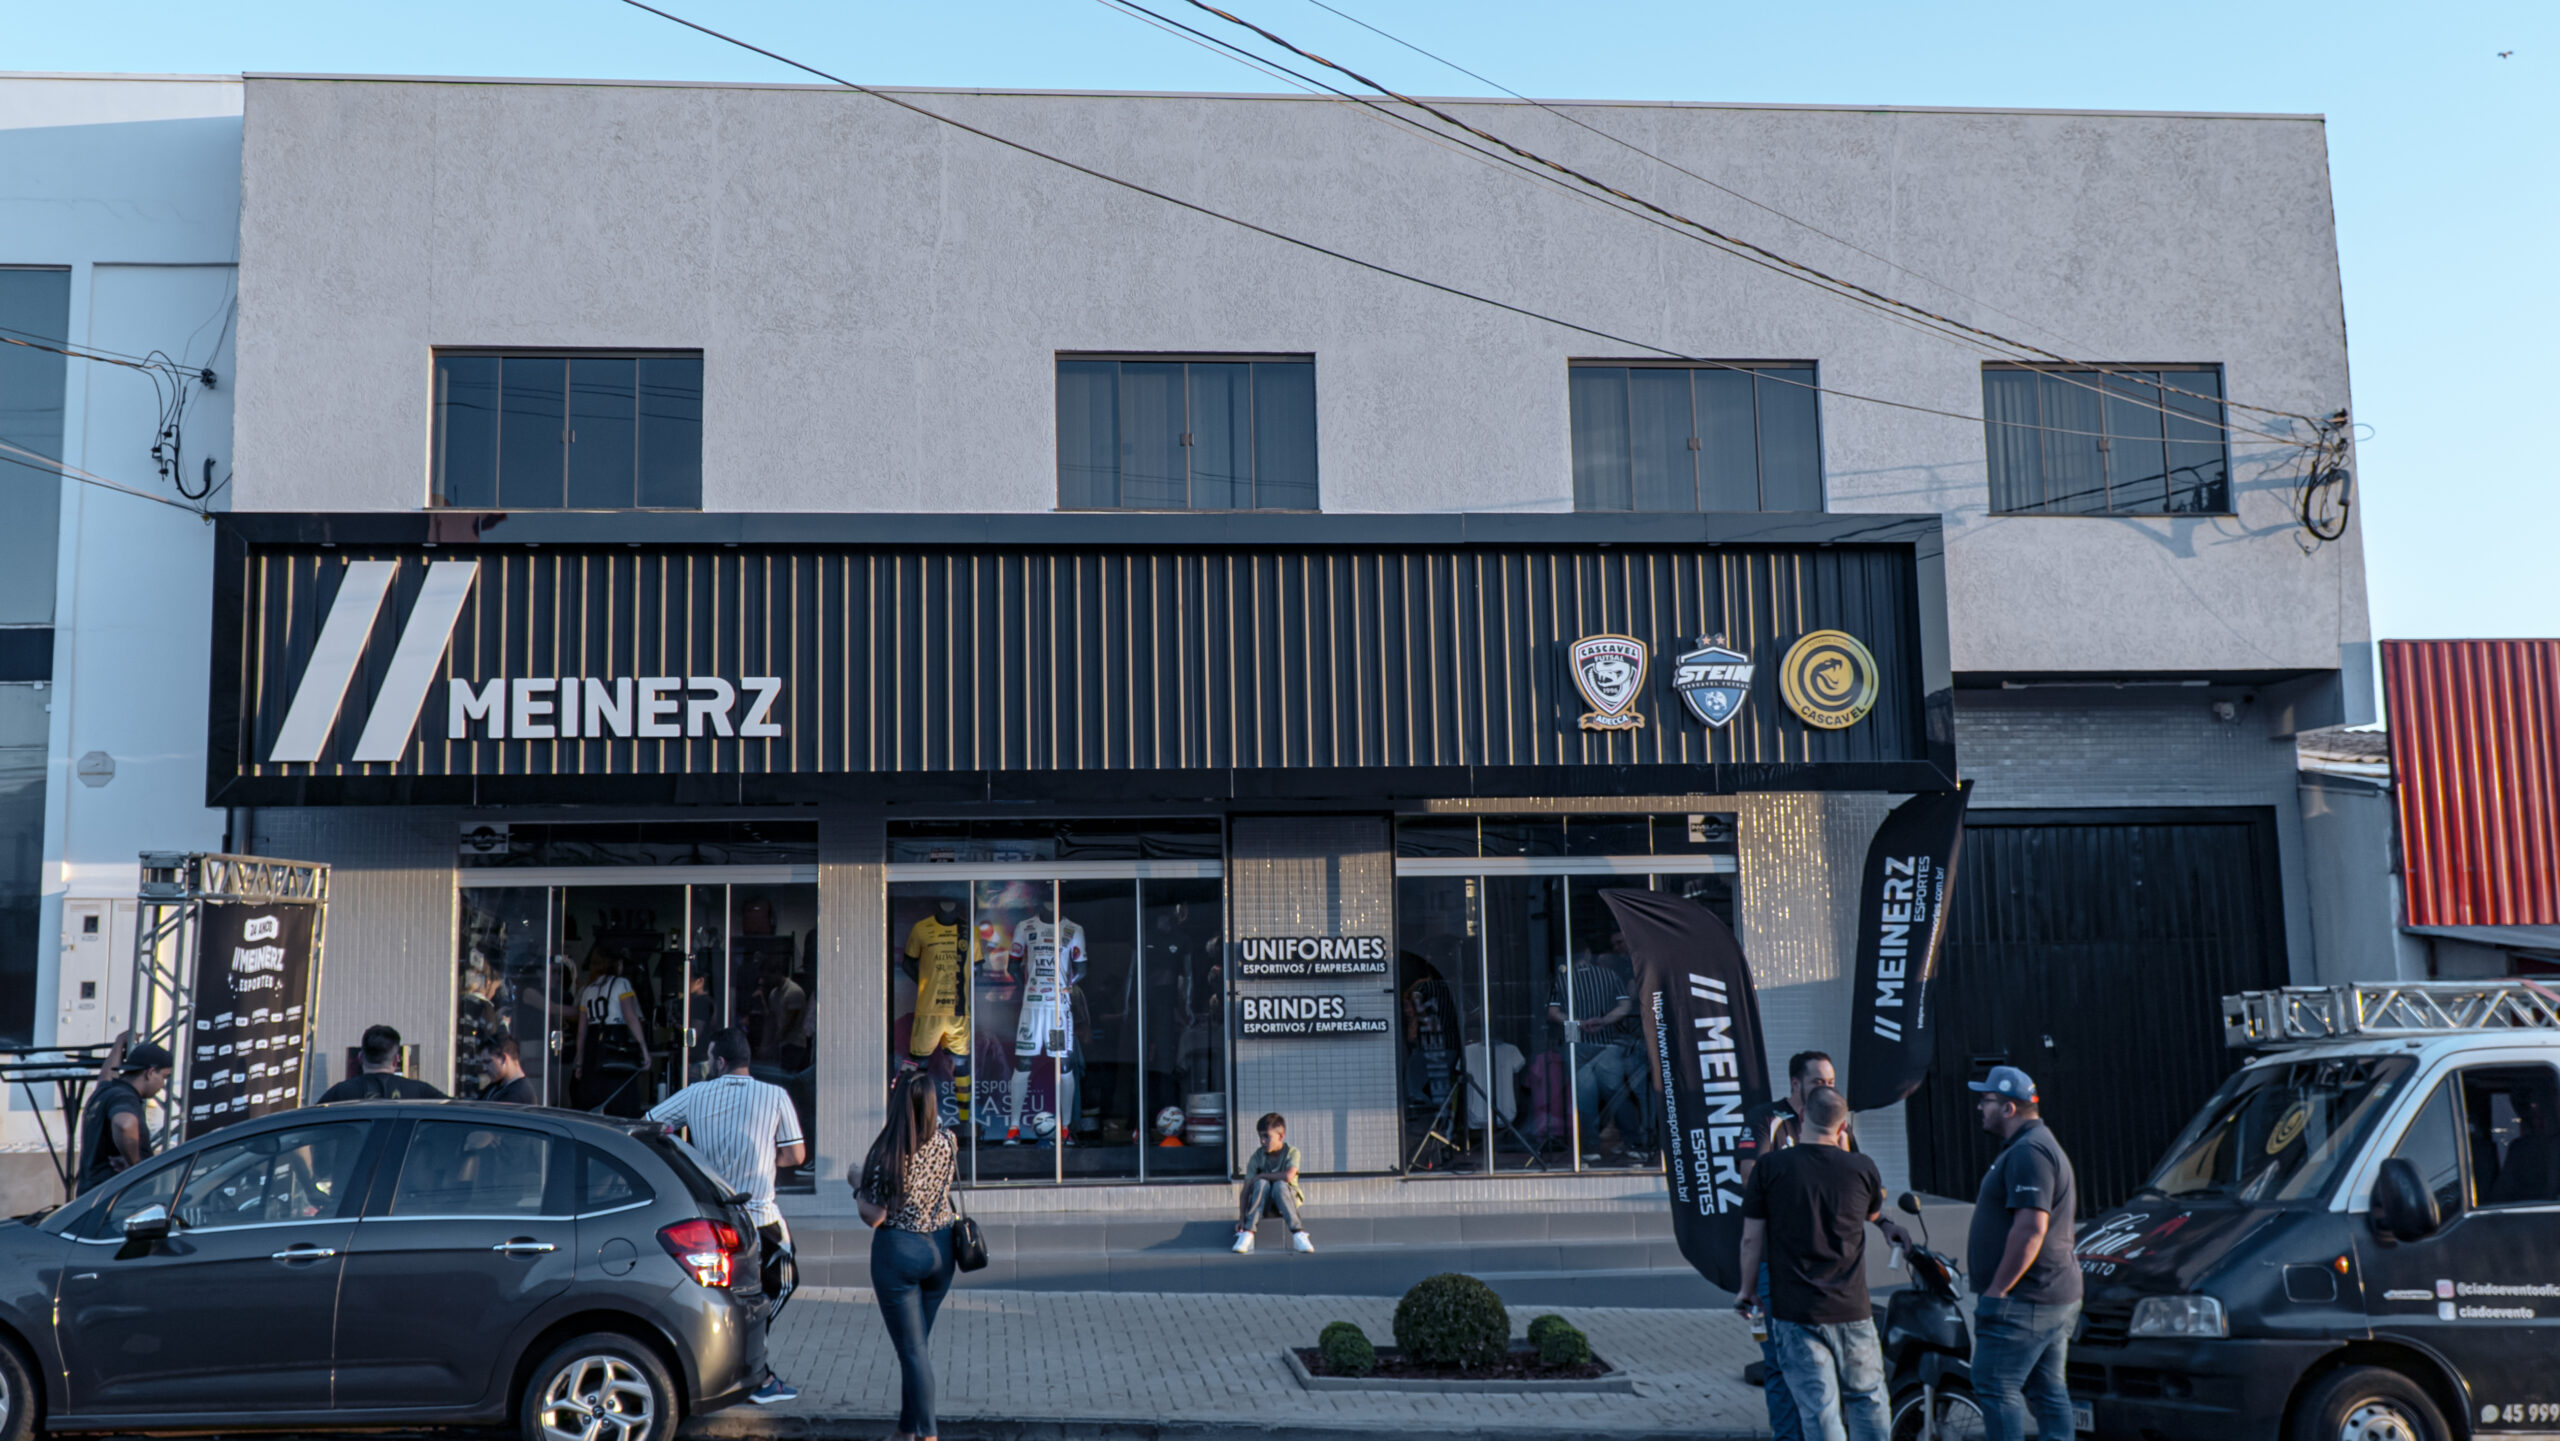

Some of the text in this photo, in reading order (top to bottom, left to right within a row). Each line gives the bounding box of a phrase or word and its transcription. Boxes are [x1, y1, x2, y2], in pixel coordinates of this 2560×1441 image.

[1581, 645, 1636, 657] CASCAVEL
[1594, 654, 1624, 662] FUTSAL
[1677, 665, 1754, 685] STEIN
[447, 676, 783, 740] MEINERZ
[1801, 705, 1866, 725] CASCAVEL
[1595, 714, 1629, 725] ADECCA
[1913, 856, 1930, 922] ESPORTES
[1875, 856, 1915, 1007] MEINERZ
[1242, 938, 1385, 961] UNIFORMES
[1243, 963, 1305, 974] ESPORTIVOS
[1315, 962, 1386, 973] EMPRESARIAIS
[587, 996, 609, 1021] 10
[1243, 997, 1345, 1020] BRINDES
[1244, 1022, 1306, 1033] ESPORTIVOS
[1316, 1020, 1387, 1032] EMPRESARIAIS
[1652, 991, 1690, 1203] https://www.meinerzesportes.com.br/
[1690, 1128, 1715, 1216] ESPORTES
[2458, 1305, 2536, 1319] ciadoevento
[2501, 1403, 2524, 1424] 45
